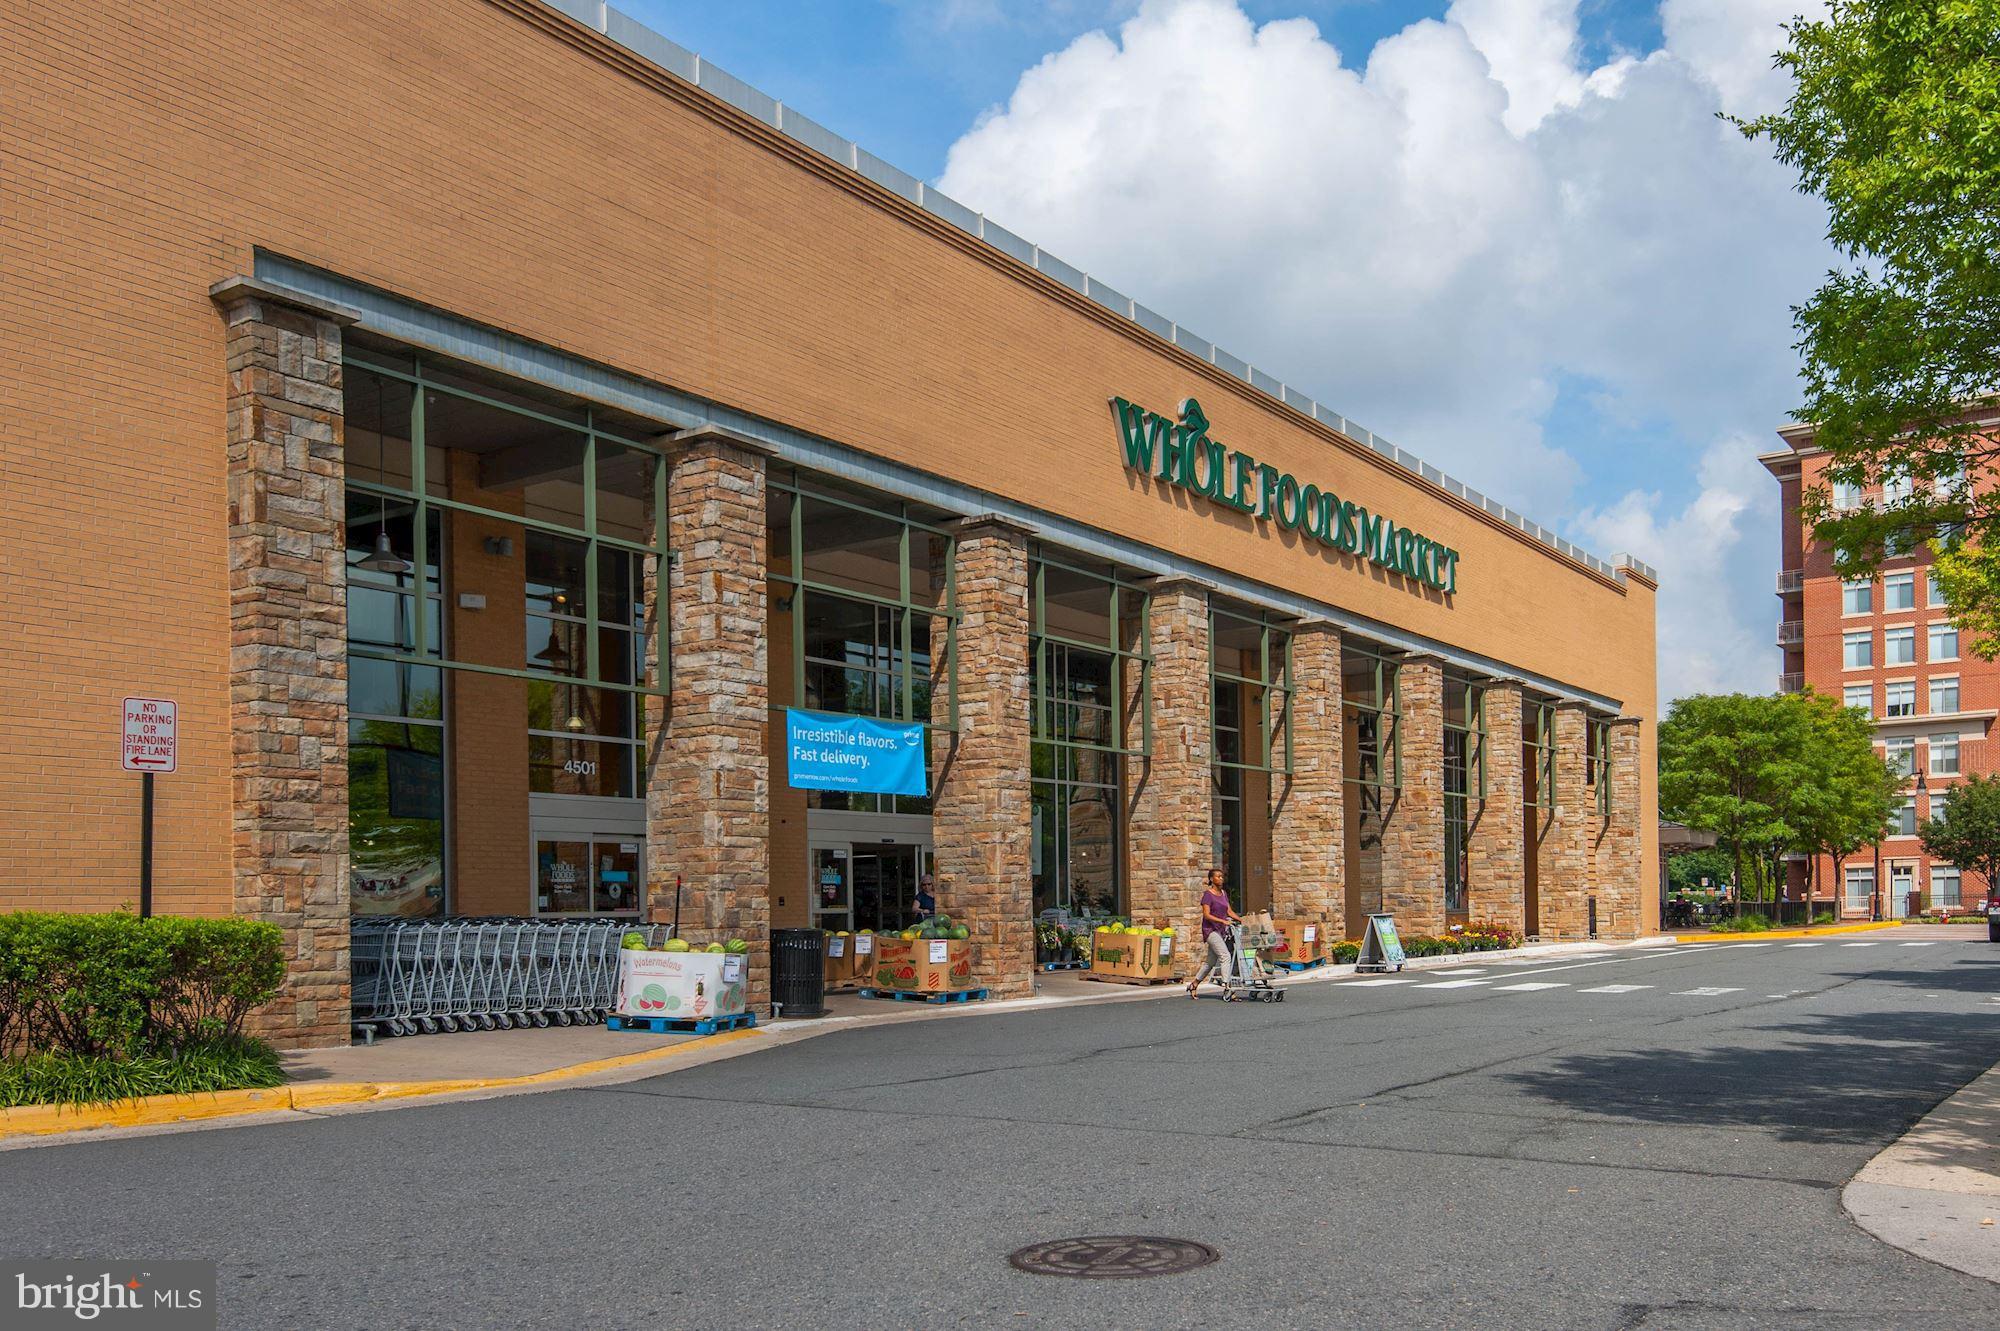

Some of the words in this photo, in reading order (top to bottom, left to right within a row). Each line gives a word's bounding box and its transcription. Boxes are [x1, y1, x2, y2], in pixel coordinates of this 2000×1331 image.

[1107, 396, 1257, 515] WHOLE
[1254, 461, 1359, 553] FOODS
[1354, 506, 1461, 595] MARKET
[143, 703, 157, 713] NO
[127, 712, 172, 725] PARKING
[142, 724, 157, 734] OR
[126, 733, 173, 746] STANDING
[793, 725, 855, 745] Irresistible
[858, 731, 898, 750] flavors.
[126, 744, 146, 755] FIRE
[148, 746, 172, 757] LANE
[793, 746, 818, 762] Fast
[820, 748, 870, 770] delivery.
[564, 759, 597, 775] 4501
[633, 956, 683, 972] Watermelons
